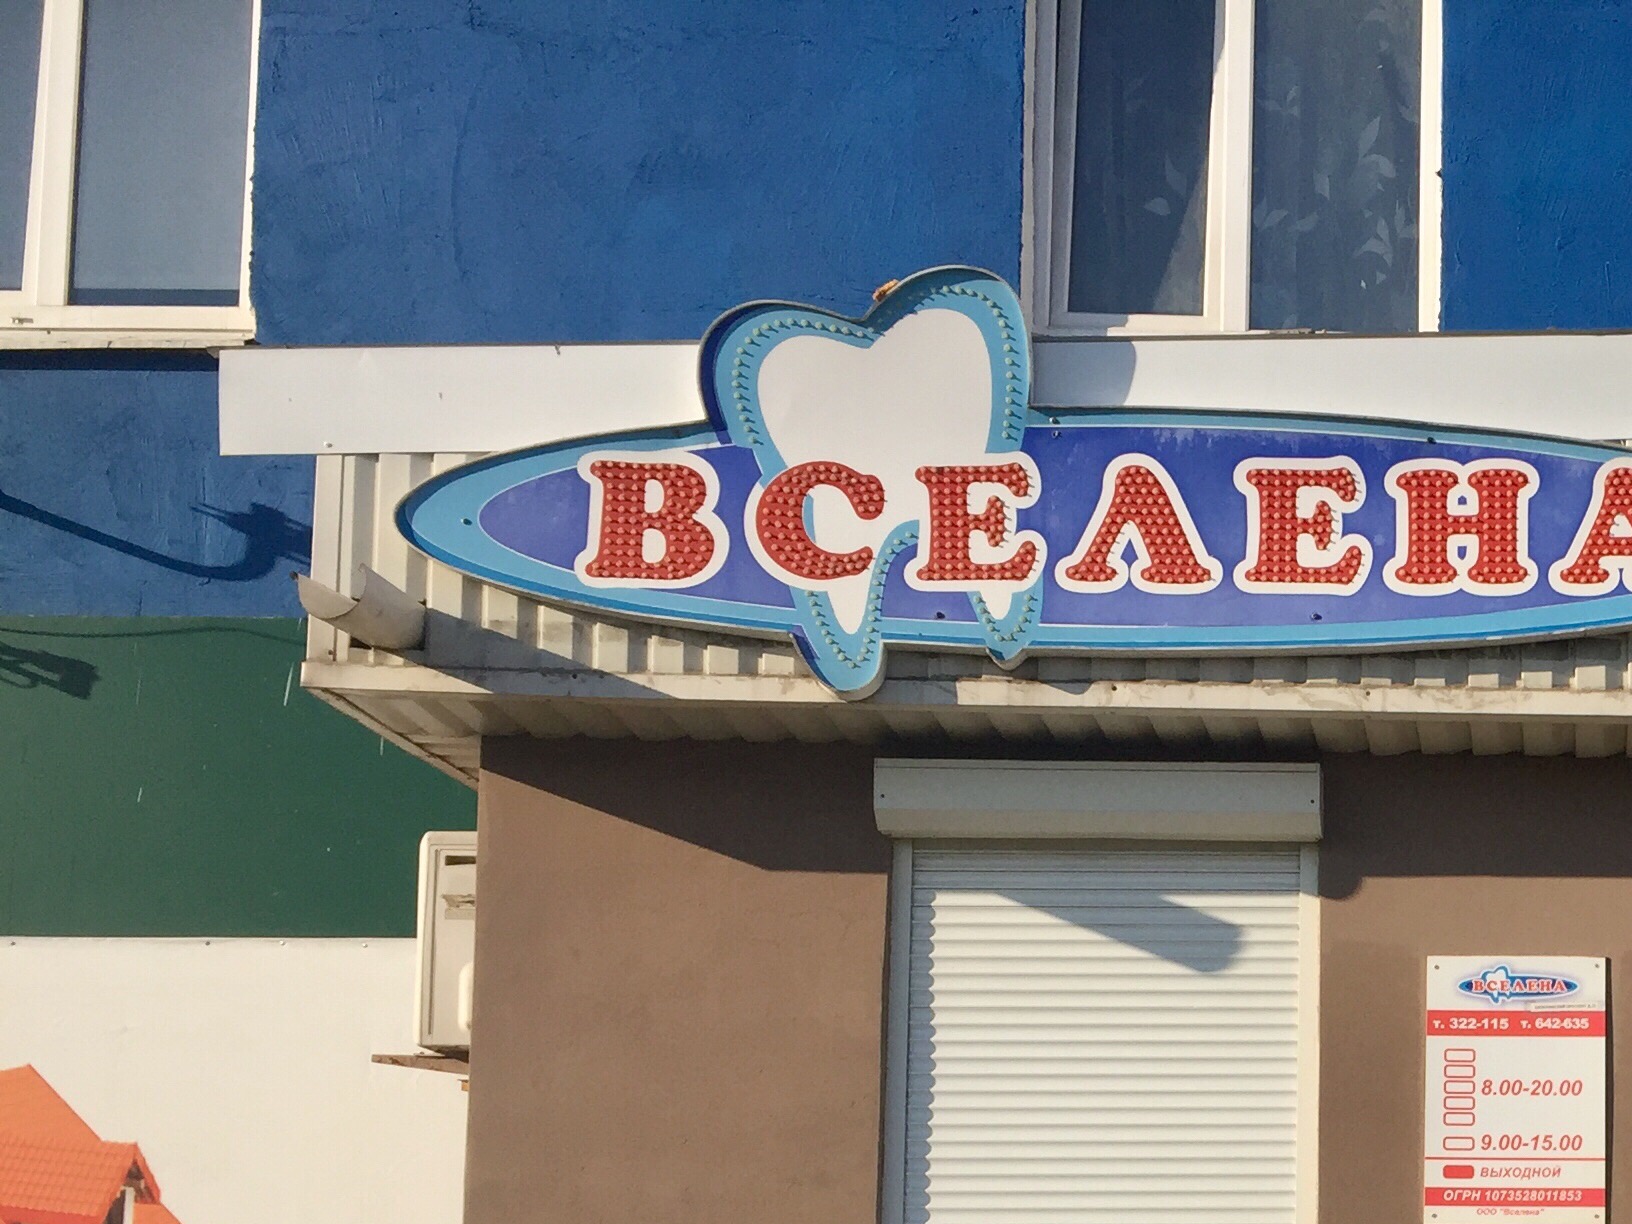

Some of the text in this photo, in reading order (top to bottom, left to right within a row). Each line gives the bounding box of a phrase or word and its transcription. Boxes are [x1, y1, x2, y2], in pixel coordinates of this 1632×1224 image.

[1473, 979, 1567, 993] ВСЕЛЕНА
[1449, 1018, 1509, 1029] 322-115
[1535, 1018, 1589, 1029] 642-635
[1481, 1080, 1583, 1096] 8.00-20.00
[1480, 1135, 1583, 1151] 9.00-15.00
[1480, 1165, 1561, 1179] ВЫХОДНОЙ
[1443, 1190, 1481, 1201] ОГРН
